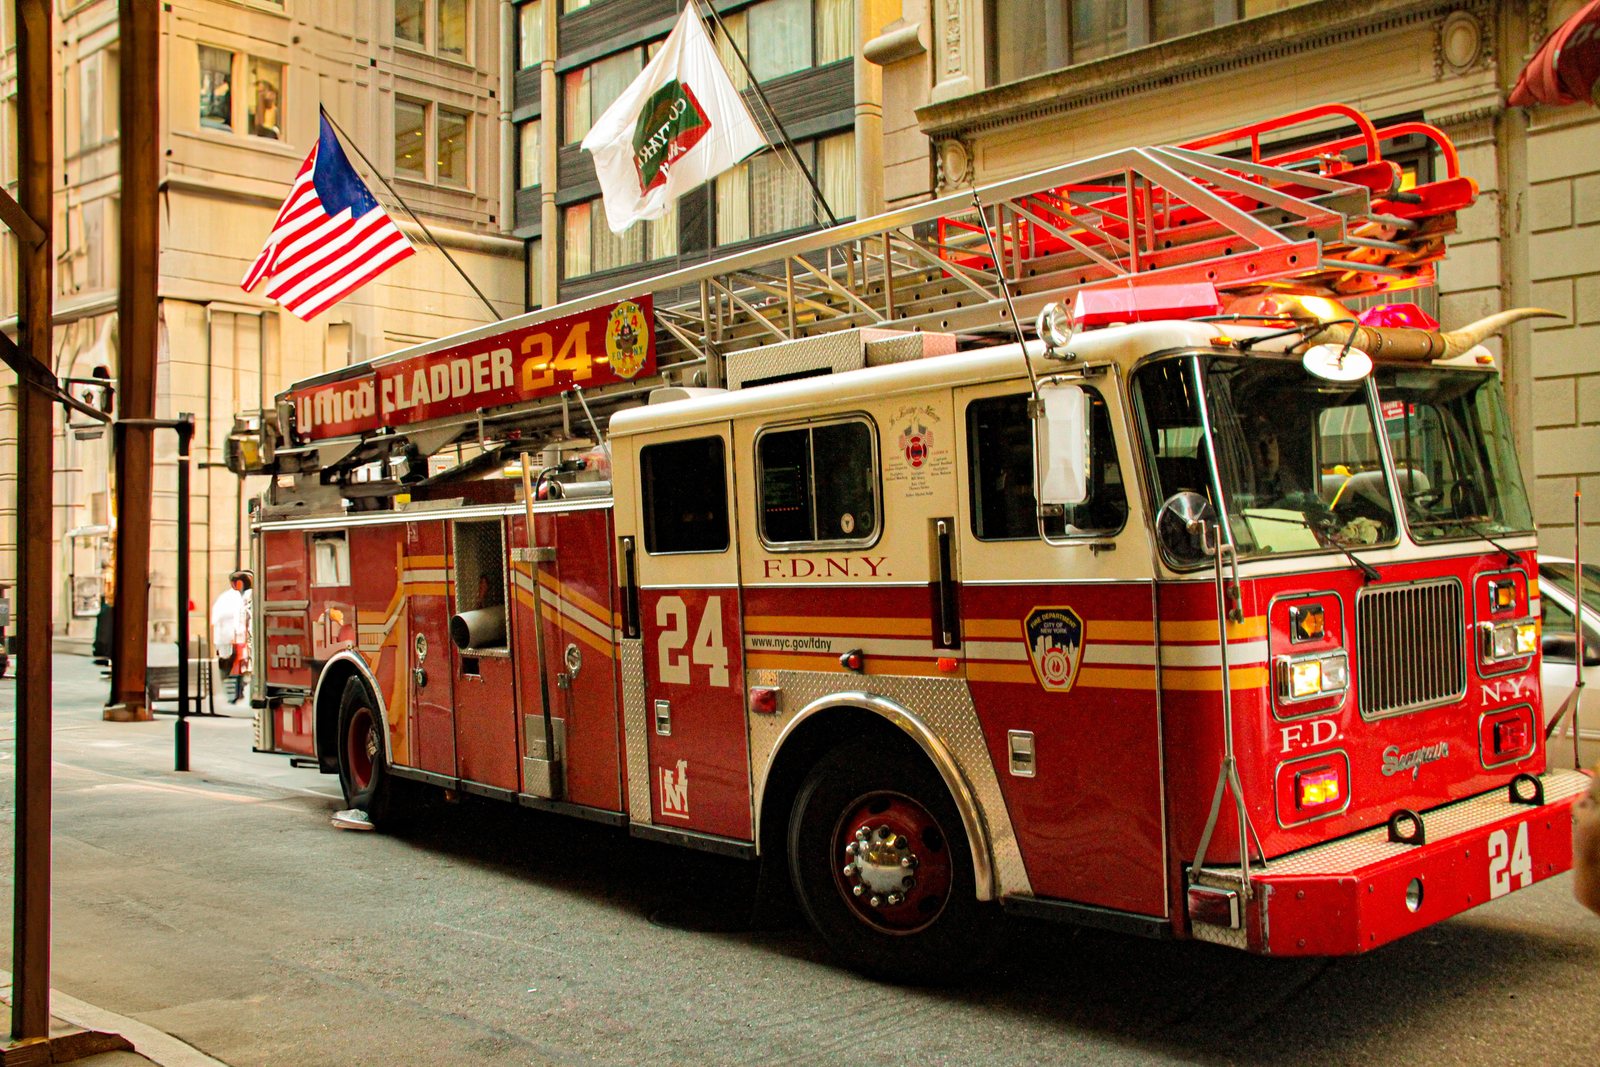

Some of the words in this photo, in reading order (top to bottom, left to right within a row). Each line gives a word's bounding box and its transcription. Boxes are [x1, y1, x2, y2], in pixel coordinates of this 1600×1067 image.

[521, 321, 592, 391] 24
[763, 556, 893, 578] F.D.N.Y.
[1030, 617, 1041, 629] FIRE
[1042, 612, 1077, 629] DEPARTMENT
[656, 595, 730, 687] 24
[751, 637, 832, 652] www.nyc.gov/fdny
[1480, 675, 1530, 706] N.Y.
[1279, 719, 1344, 753] F.D.
[1488, 820, 1533, 900] 24
